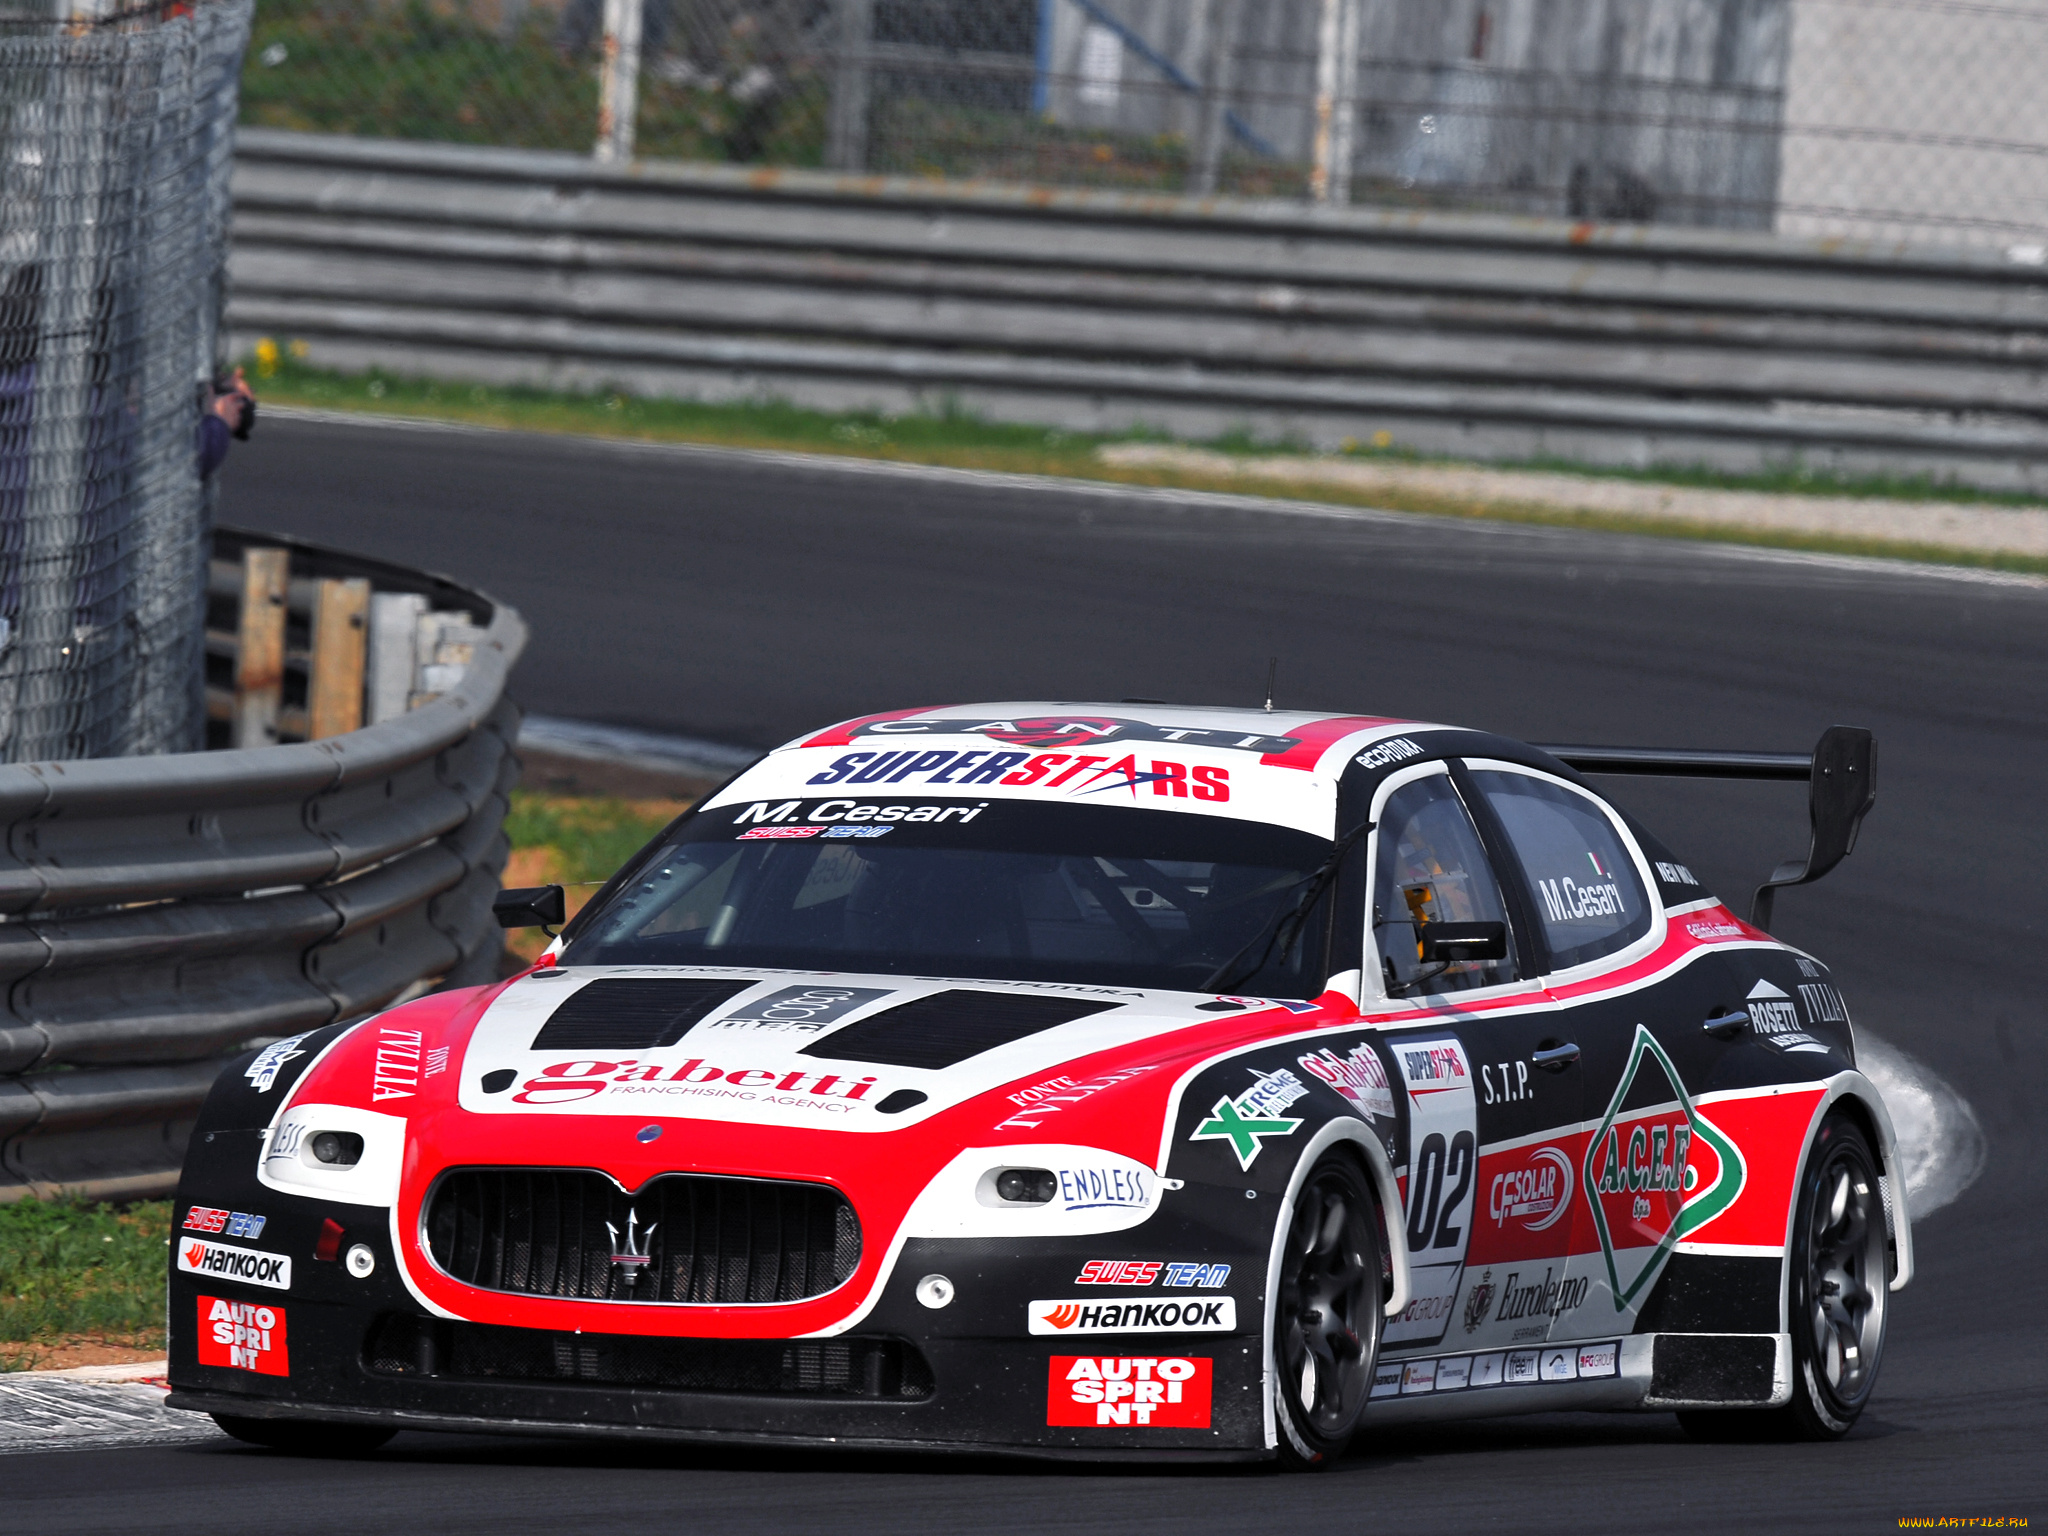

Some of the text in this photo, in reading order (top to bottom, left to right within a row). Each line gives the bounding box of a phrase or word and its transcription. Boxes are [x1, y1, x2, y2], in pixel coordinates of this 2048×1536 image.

[868, 718, 1266, 748] CANTI
[805, 750, 1231, 803] SUPERSTARS
[733, 800, 989, 824] M. Cesari
[736, 825, 894, 840] SWISS TEAM
[1747, 1002, 1802, 1034] ROSETTI
[372, 1028, 422, 1102] TVLLIA
[424, 1046, 449, 1078] FONTE
[1404, 1047, 1465, 1081] SUPERSTARS
[512, 1059, 878, 1104] gabetti
[1006, 1075, 1082, 1107] FONTE
[1482, 1061, 1533, 1105] S.T.P.
[610, 1085, 857, 1114] FRANCHISING AGENCY
[1599, 1124, 1699, 1195] A.C.E.F.
[1059, 1169, 1144, 1202] ENDLESS
[1407, 1130, 1474, 1252] 02
[1513, 1166, 1556, 1203] SOLAR
[182, 1205, 267, 1239] SWISS TEAM
[1074, 1260, 1231, 1288] SWISS TEAM
[1495, 1267, 1588, 1324] Eurolegno
[208, 1300, 277, 1330] AUTO
[212, 1323, 271, 1351] SPRI
[230, 1347, 260, 1370] NT
[1065, 1358, 1196, 1381] AUTO
[1071, 1380, 1183, 1403] SPRI
[1097, 1402, 1157, 1425] NT
